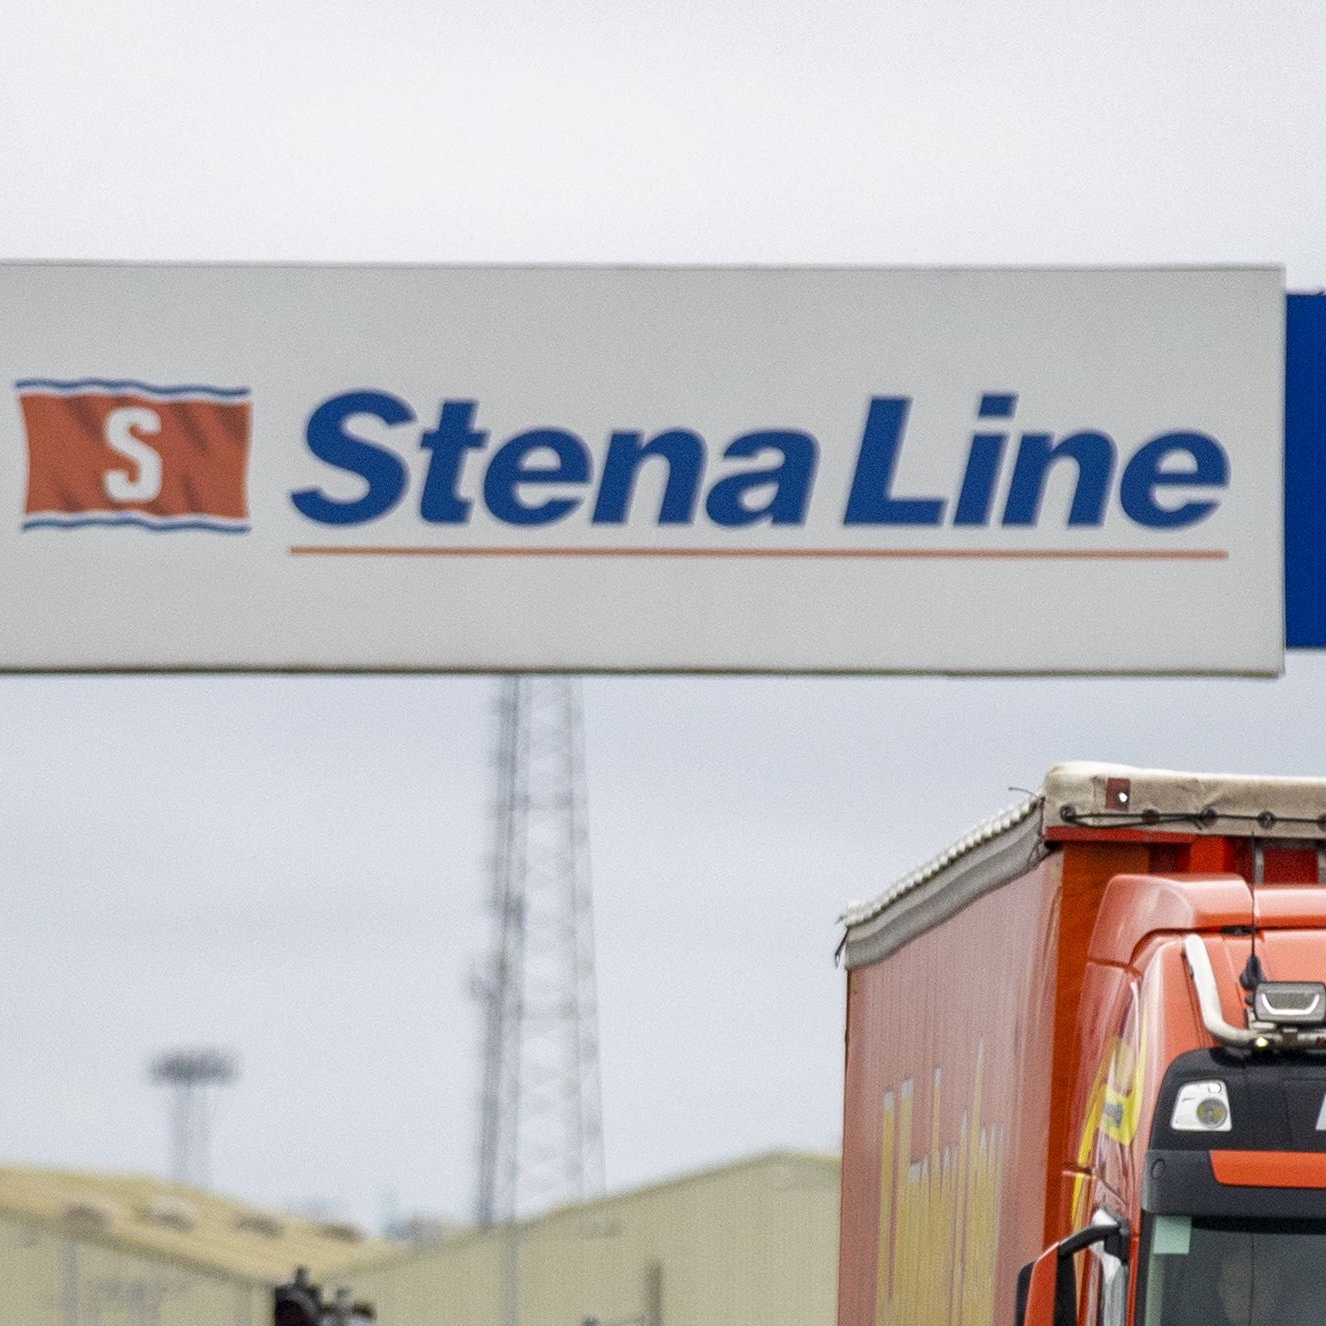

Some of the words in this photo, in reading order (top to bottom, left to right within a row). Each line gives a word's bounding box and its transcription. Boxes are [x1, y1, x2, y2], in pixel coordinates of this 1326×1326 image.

[102, 404, 165, 506] S
[289, 389, 820, 530] Stena
[841, 393, 1231, 531] Line
